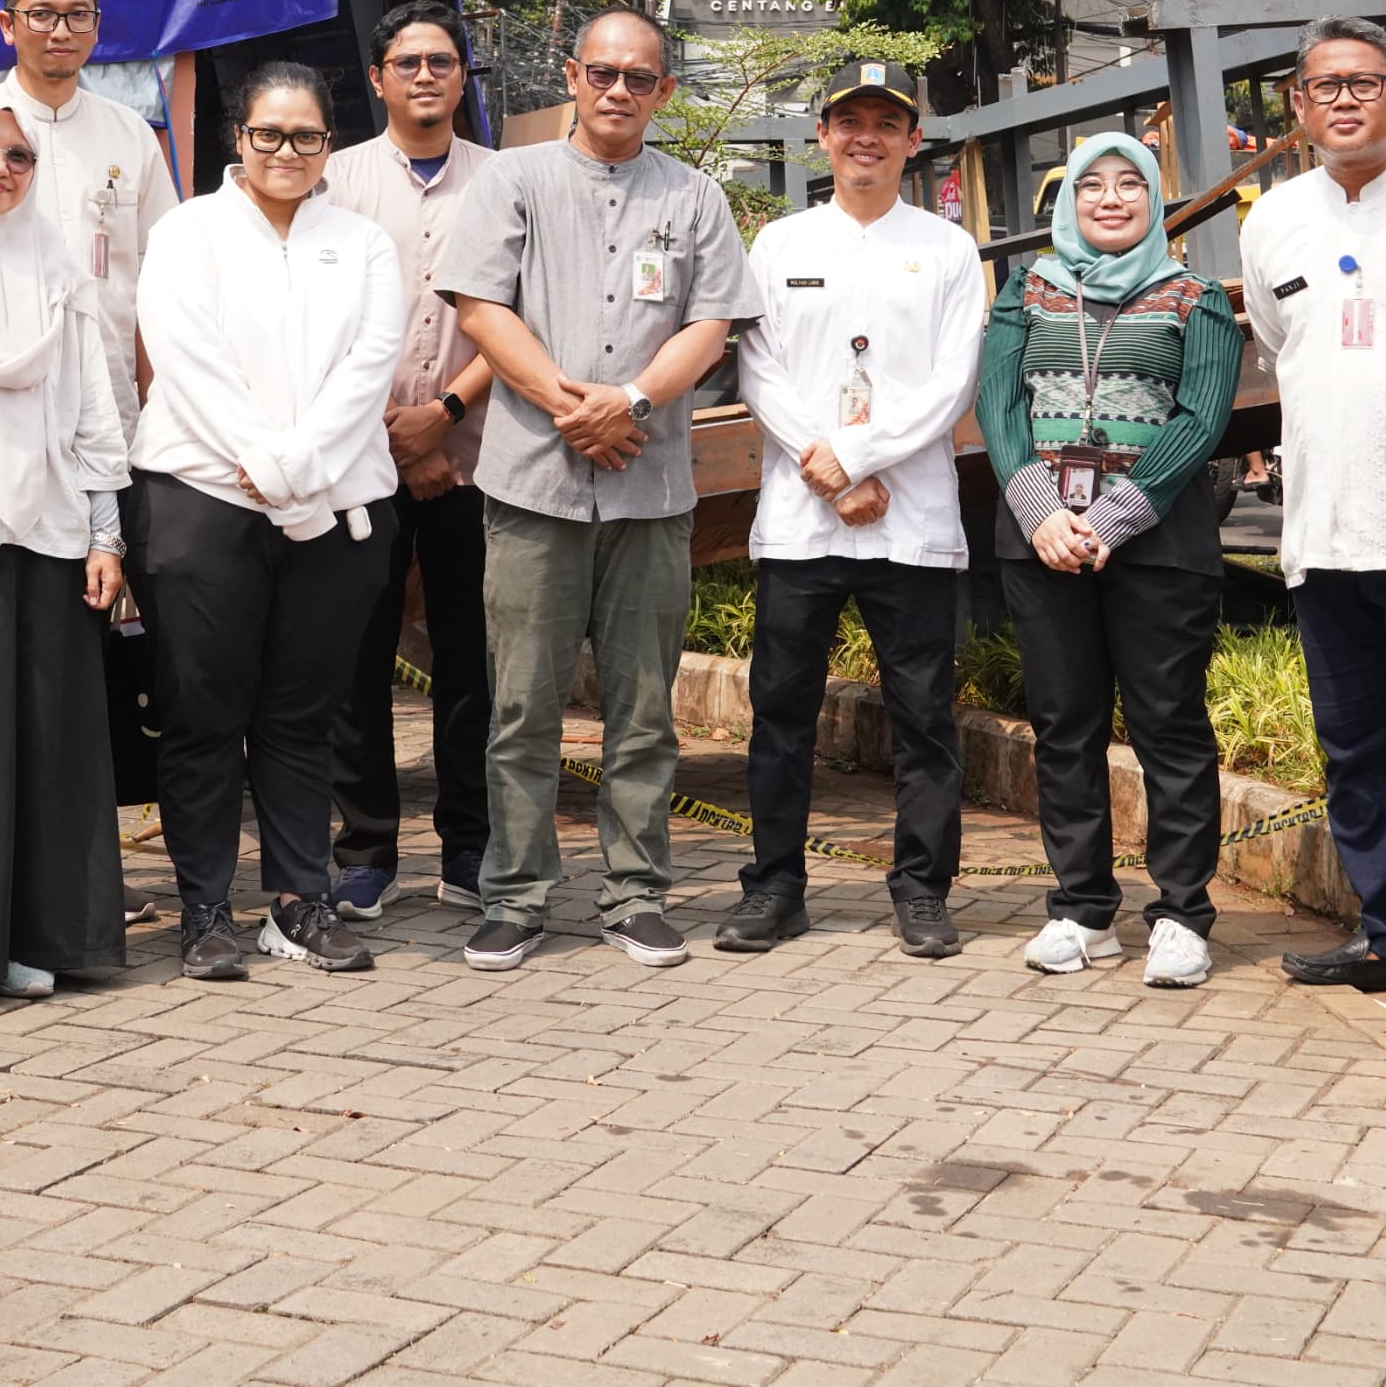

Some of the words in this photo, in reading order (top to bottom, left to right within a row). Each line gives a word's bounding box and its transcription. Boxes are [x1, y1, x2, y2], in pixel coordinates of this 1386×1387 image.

[710, 0, 814, 12] CENTANG
[1281, 281, 1300, 294] PANJI
[568, 759, 603, 783] DCKTR
